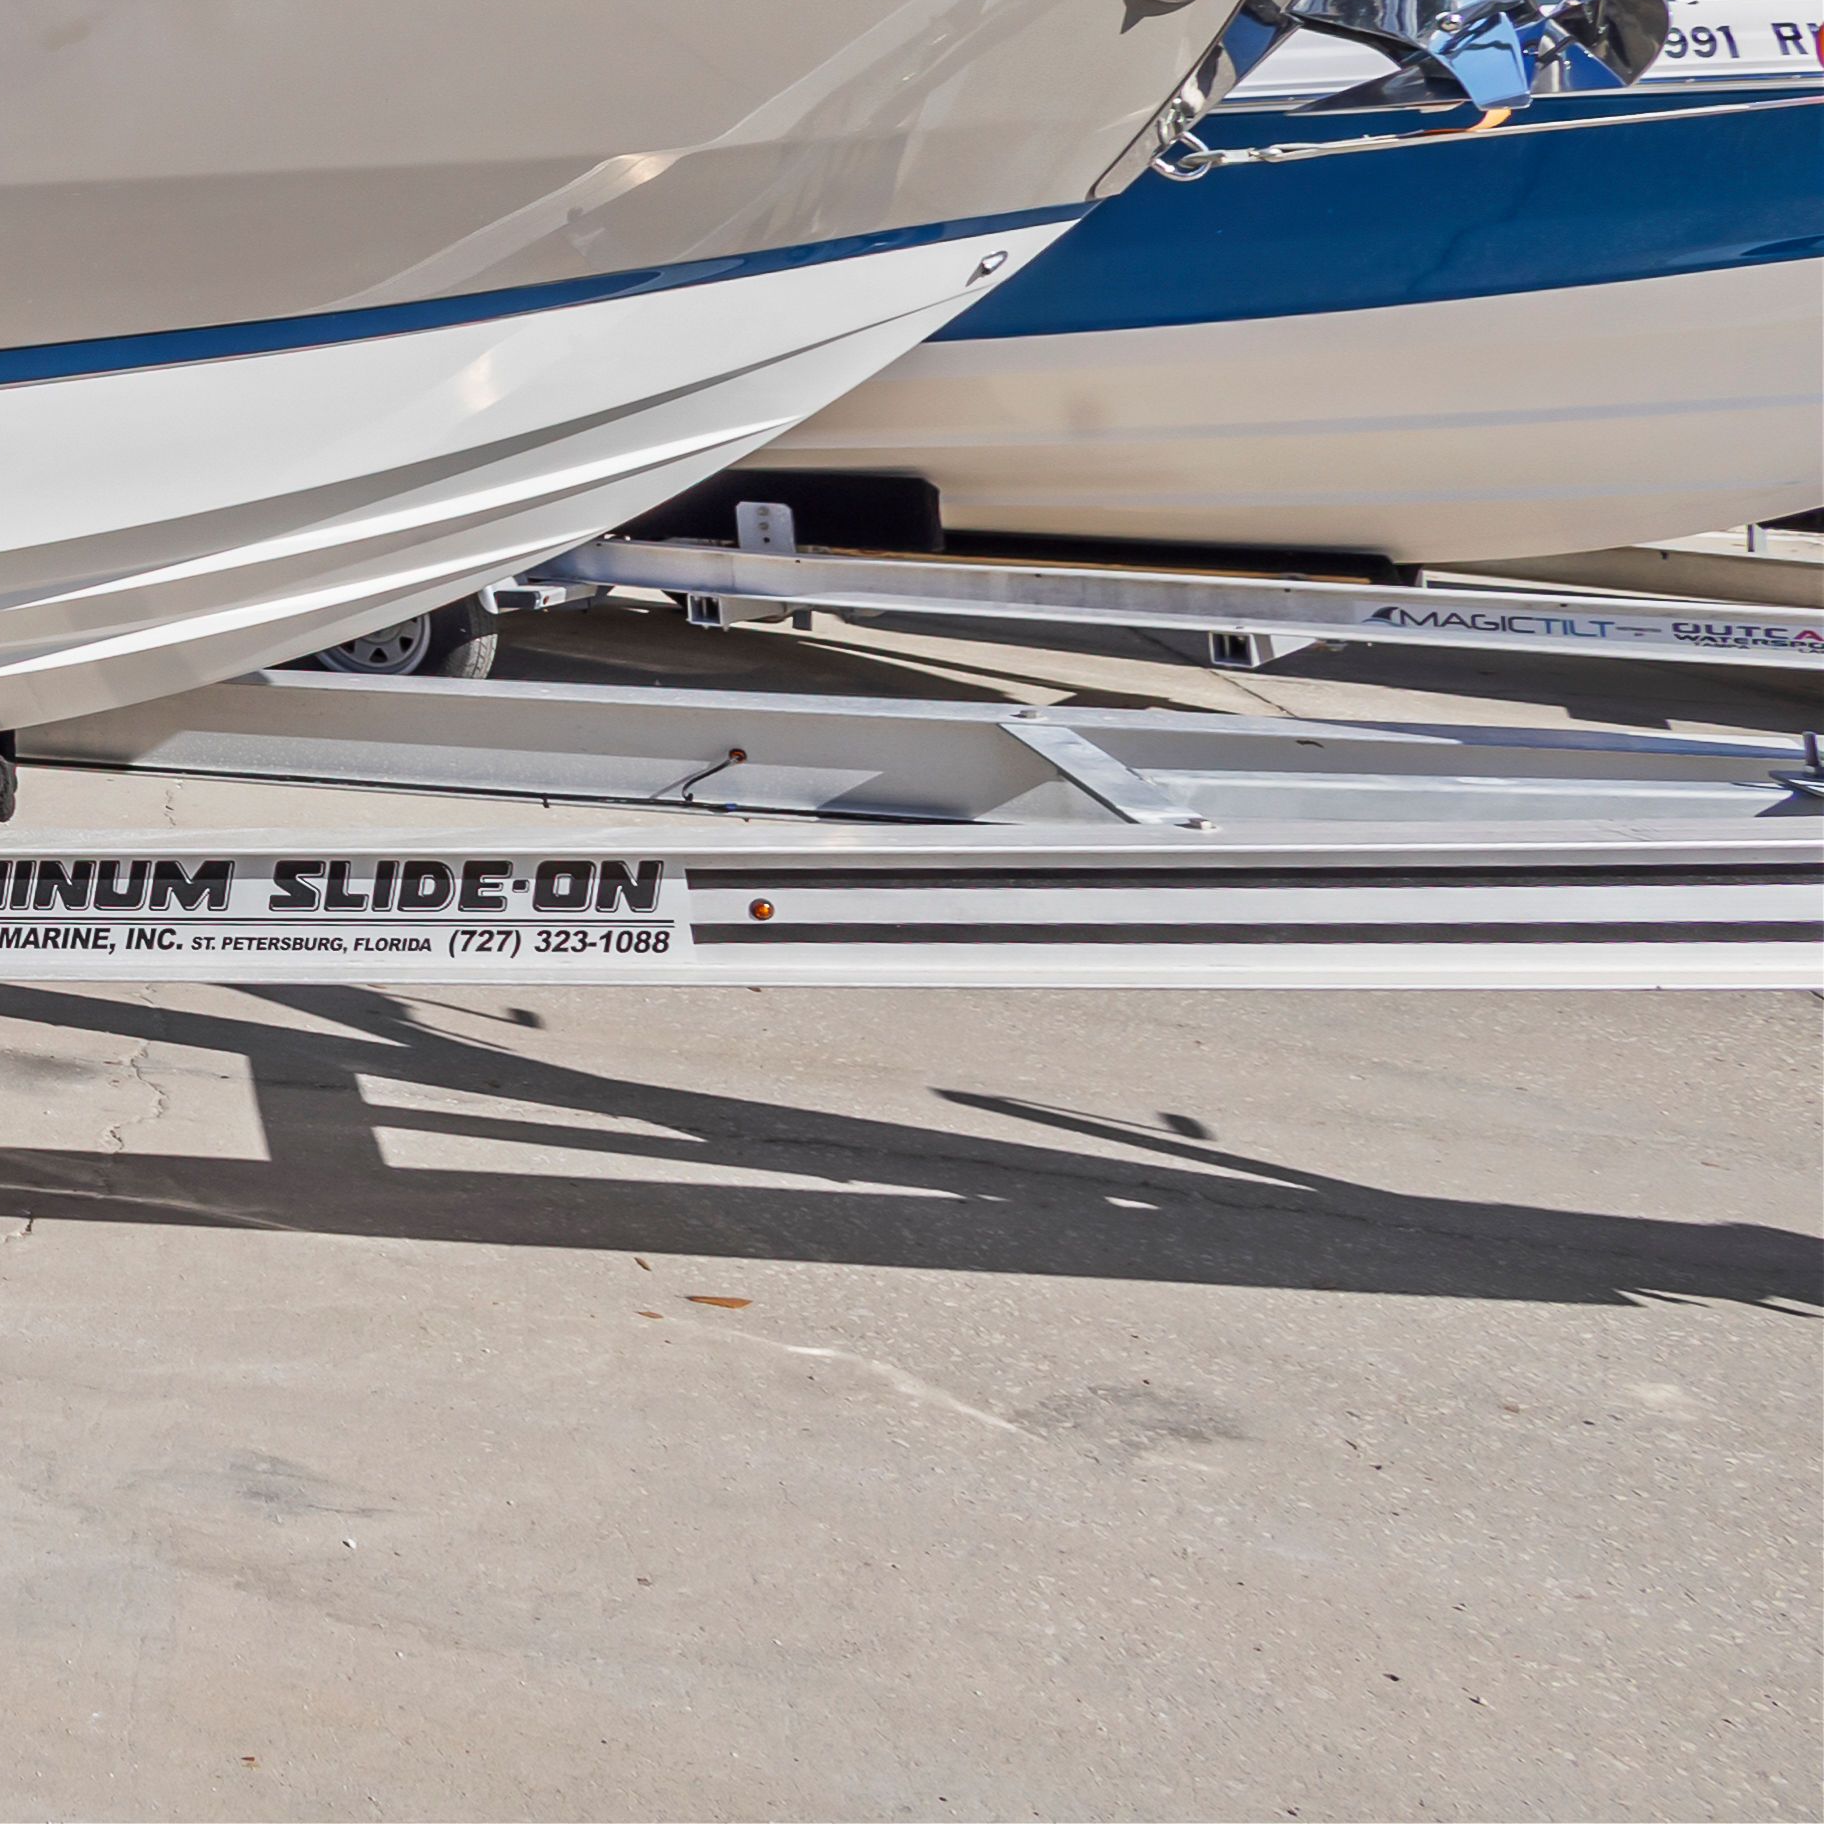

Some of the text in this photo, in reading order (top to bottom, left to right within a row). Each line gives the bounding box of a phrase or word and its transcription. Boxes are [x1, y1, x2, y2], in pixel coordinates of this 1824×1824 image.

[1399, 609, 1615, 638] MAGICTILT
[125, 927, 183, 950] INC.
[191, 936, 216, 951] ST.
[221, 937, 348, 954] PETERSBURG,
[353, 937, 432, 952] FLORIDA
[449, 929, 521, 959] (727)
[534, 929, 671, 954] 323-1088
